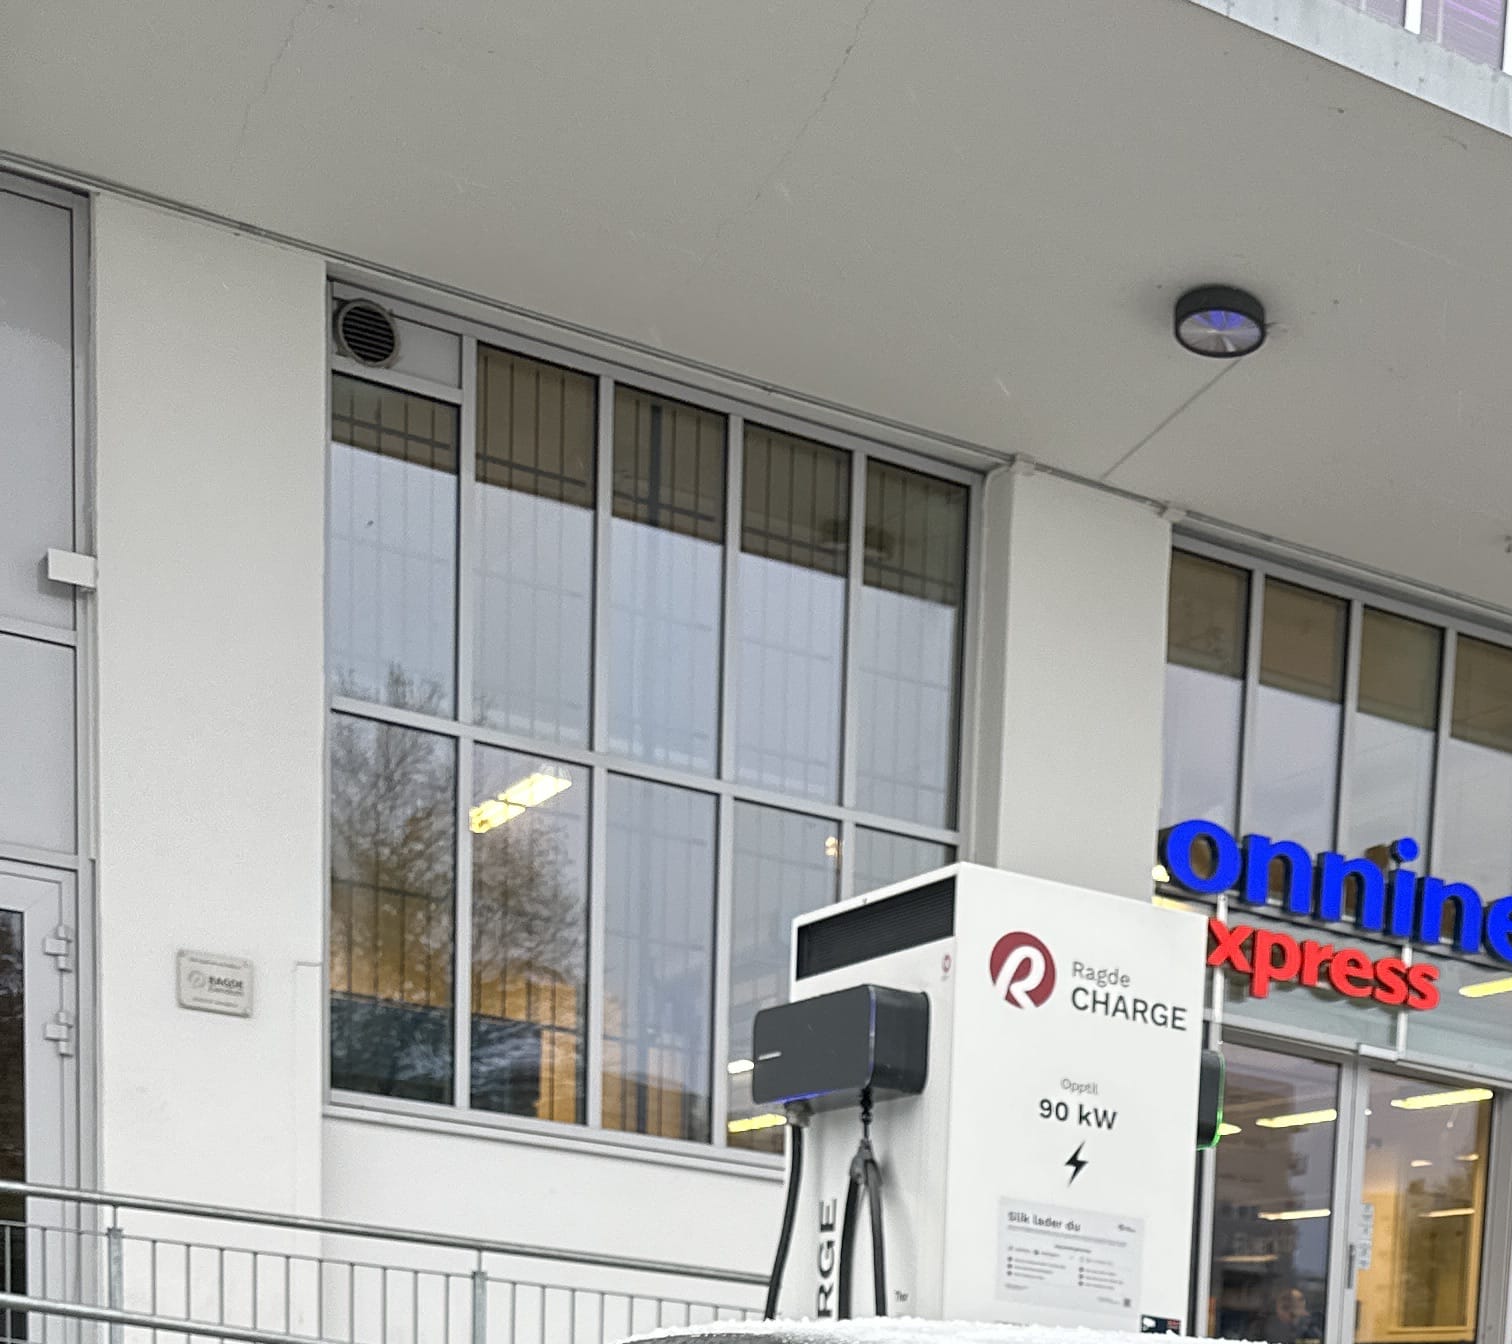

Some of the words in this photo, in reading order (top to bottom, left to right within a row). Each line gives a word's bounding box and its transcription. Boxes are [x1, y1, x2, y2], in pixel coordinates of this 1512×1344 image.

[1072, 960, 1131, 988] Ragde
[1071, 986, 1188, 1031] CHARGE
[1039, 1098, 1069, 1122] 90
[1078, 1103, 1118, 1130] kW
